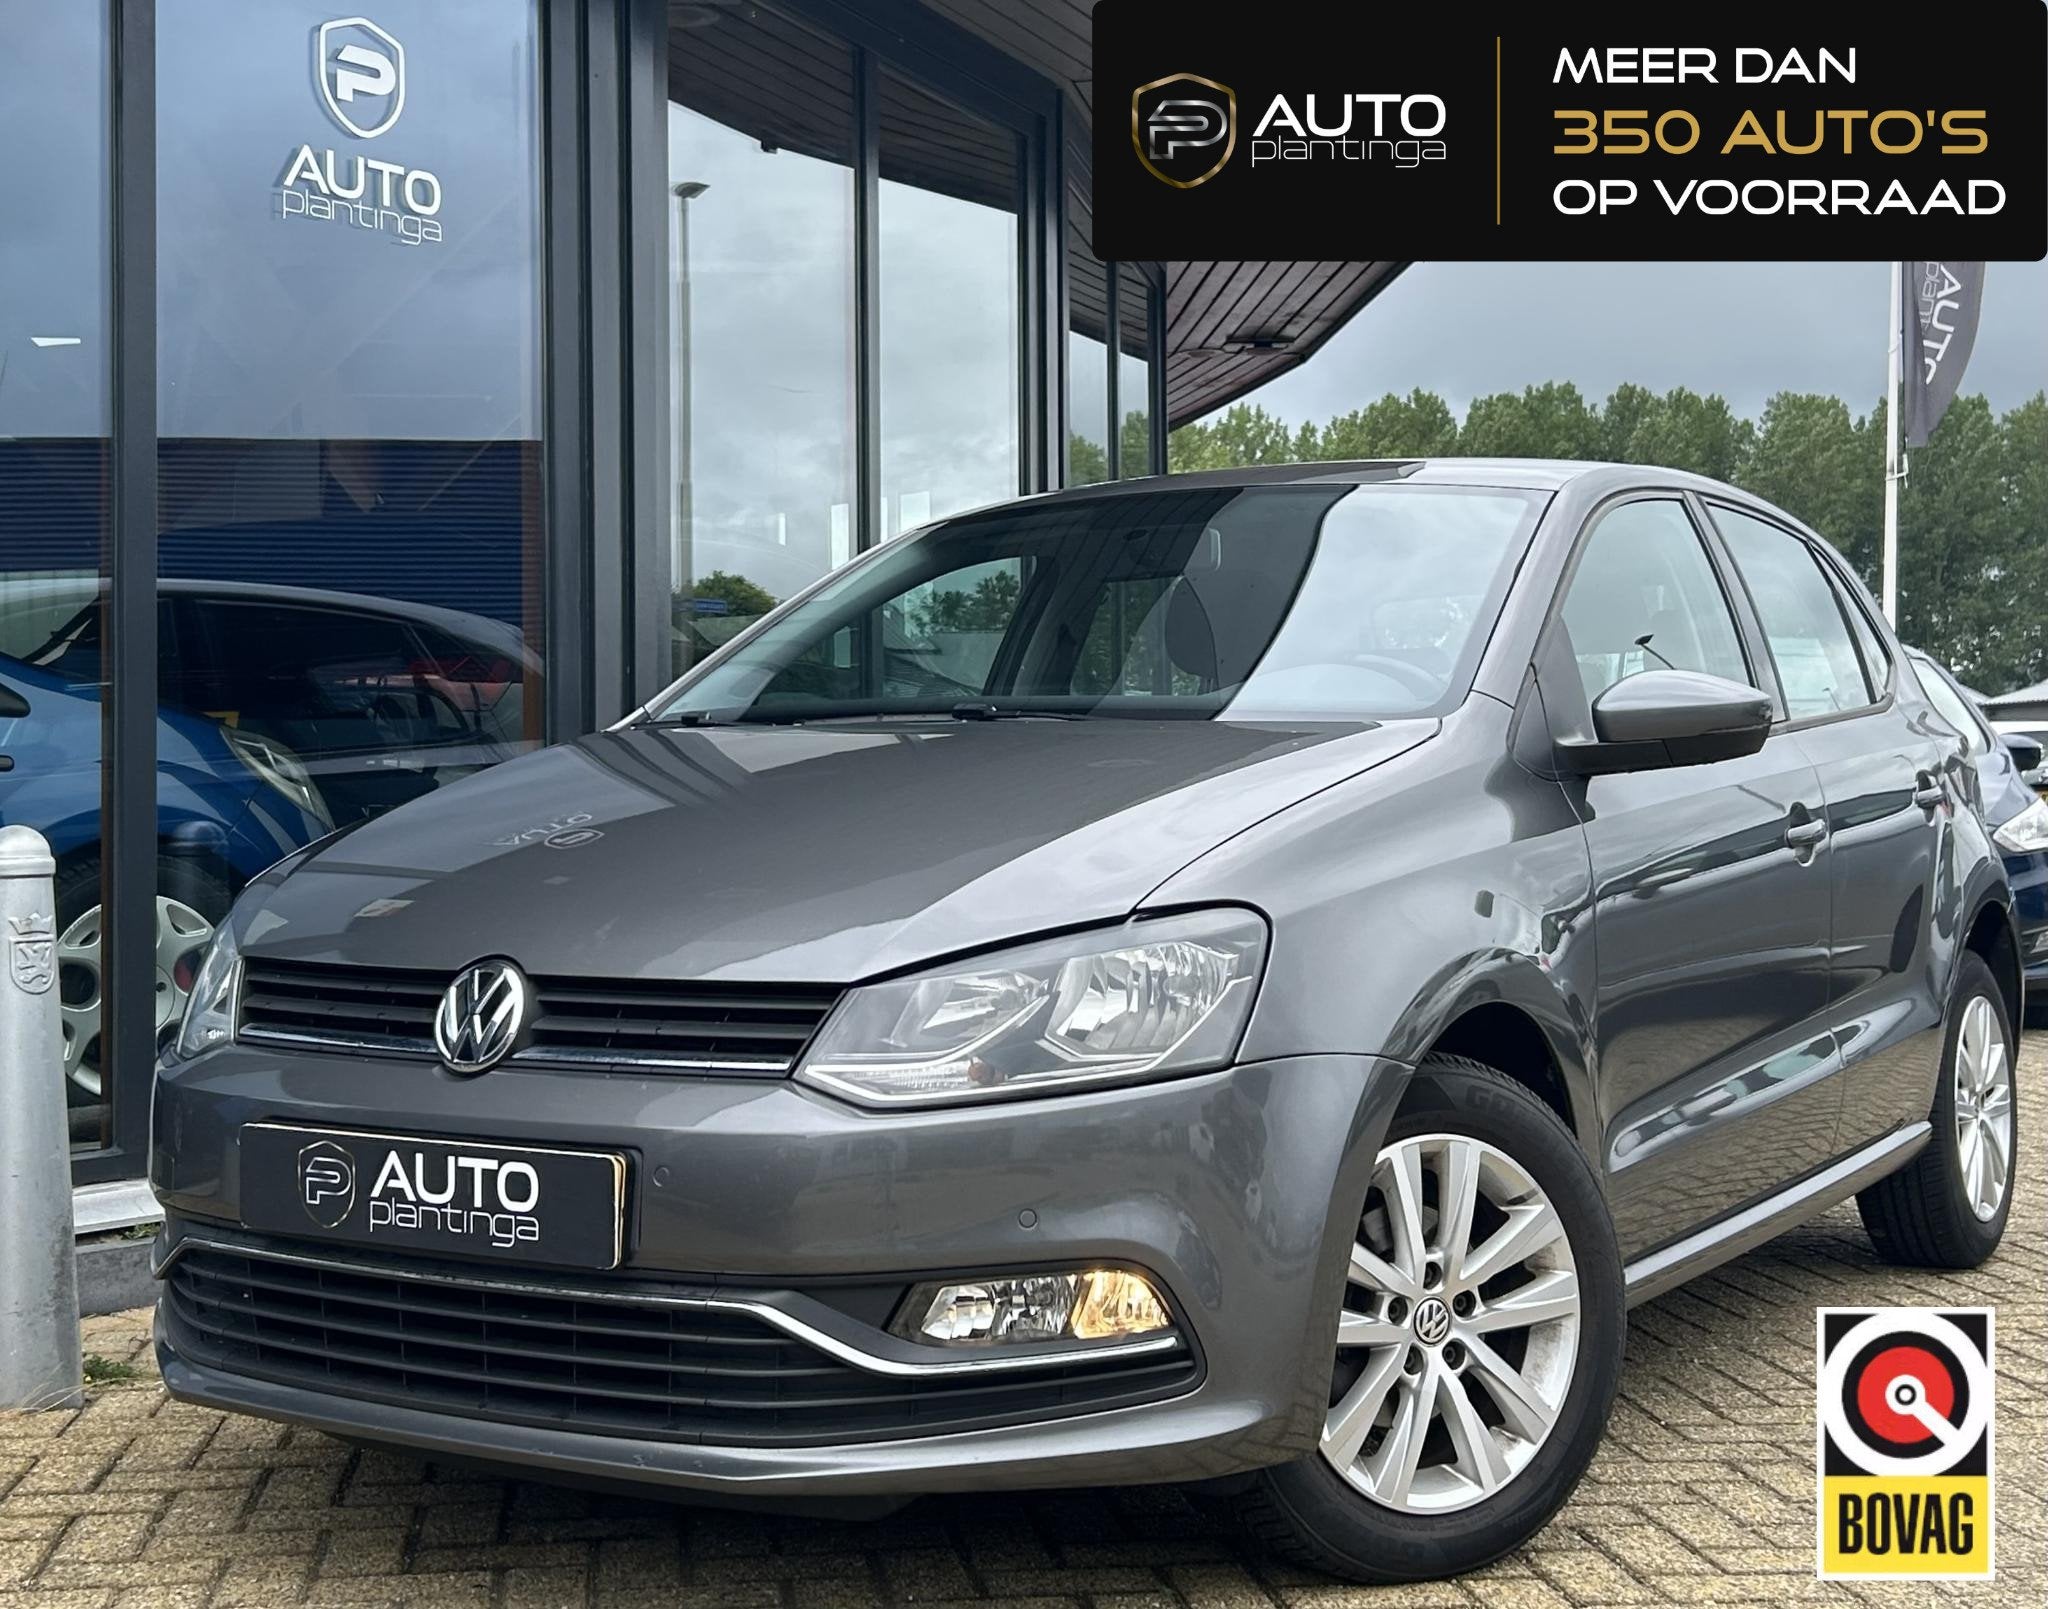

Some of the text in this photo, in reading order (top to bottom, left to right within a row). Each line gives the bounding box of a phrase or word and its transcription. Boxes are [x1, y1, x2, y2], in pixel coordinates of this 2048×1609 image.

[283, 144, 442, 216] AUTO
[282, 189, 443, 246] plantinga
[370, 1150, 540, 1213] AUTO
[369, 1197, 540, 1248] plantinga
